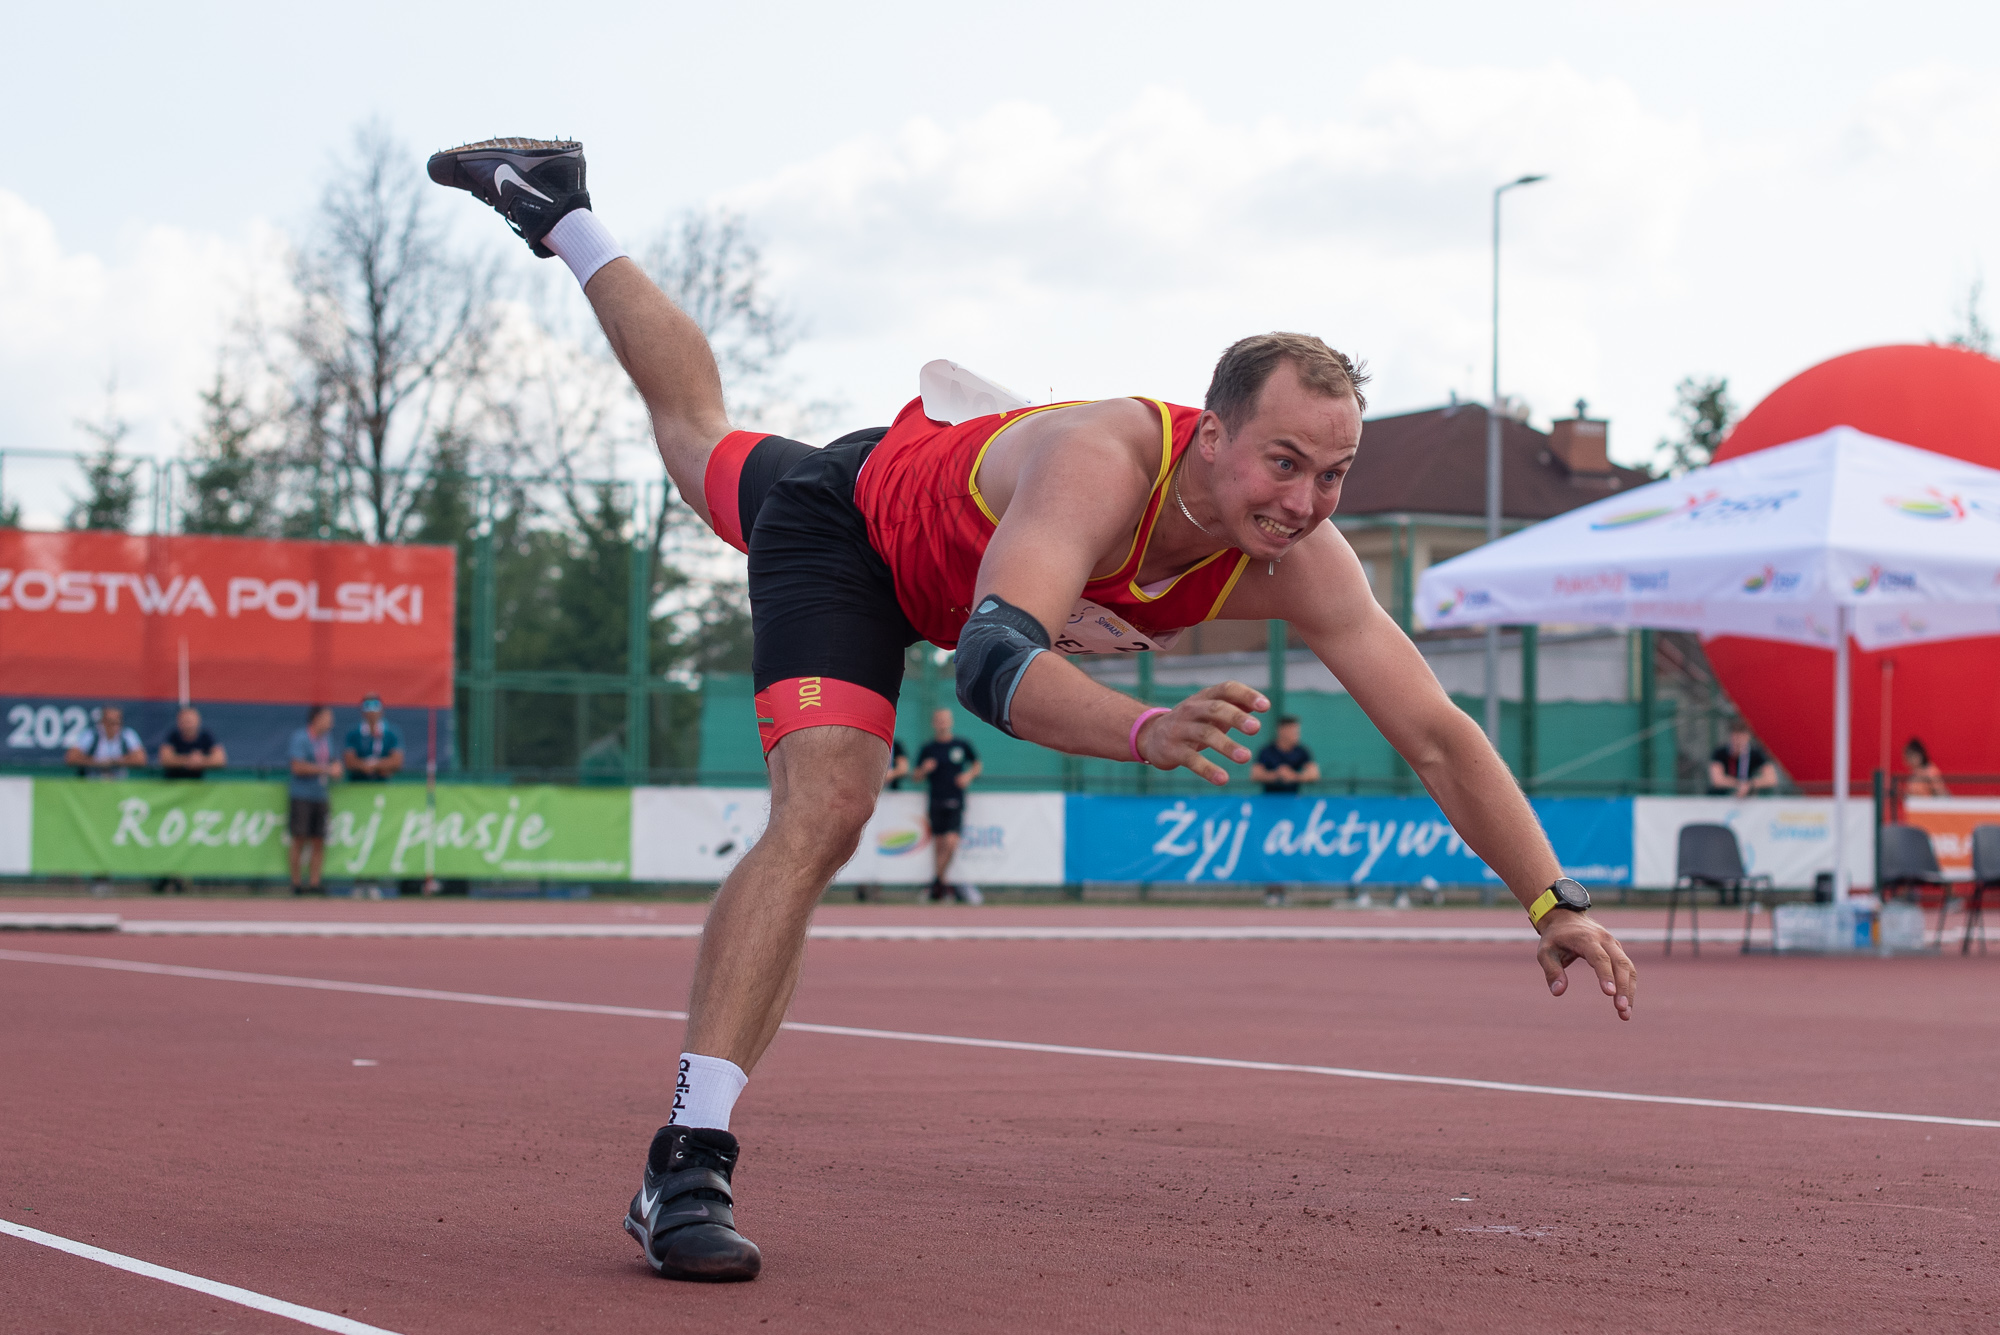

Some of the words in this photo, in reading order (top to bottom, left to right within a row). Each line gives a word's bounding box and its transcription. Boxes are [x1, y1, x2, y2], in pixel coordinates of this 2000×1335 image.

[227, 576, 424, 626] POLSKI
[7, 703, 103, 749] 202
[112, 797, 386, 873] Rozwaj
[391, 796, 554, 874] pasje
[1152, 801, 1253, 883] Żyj
